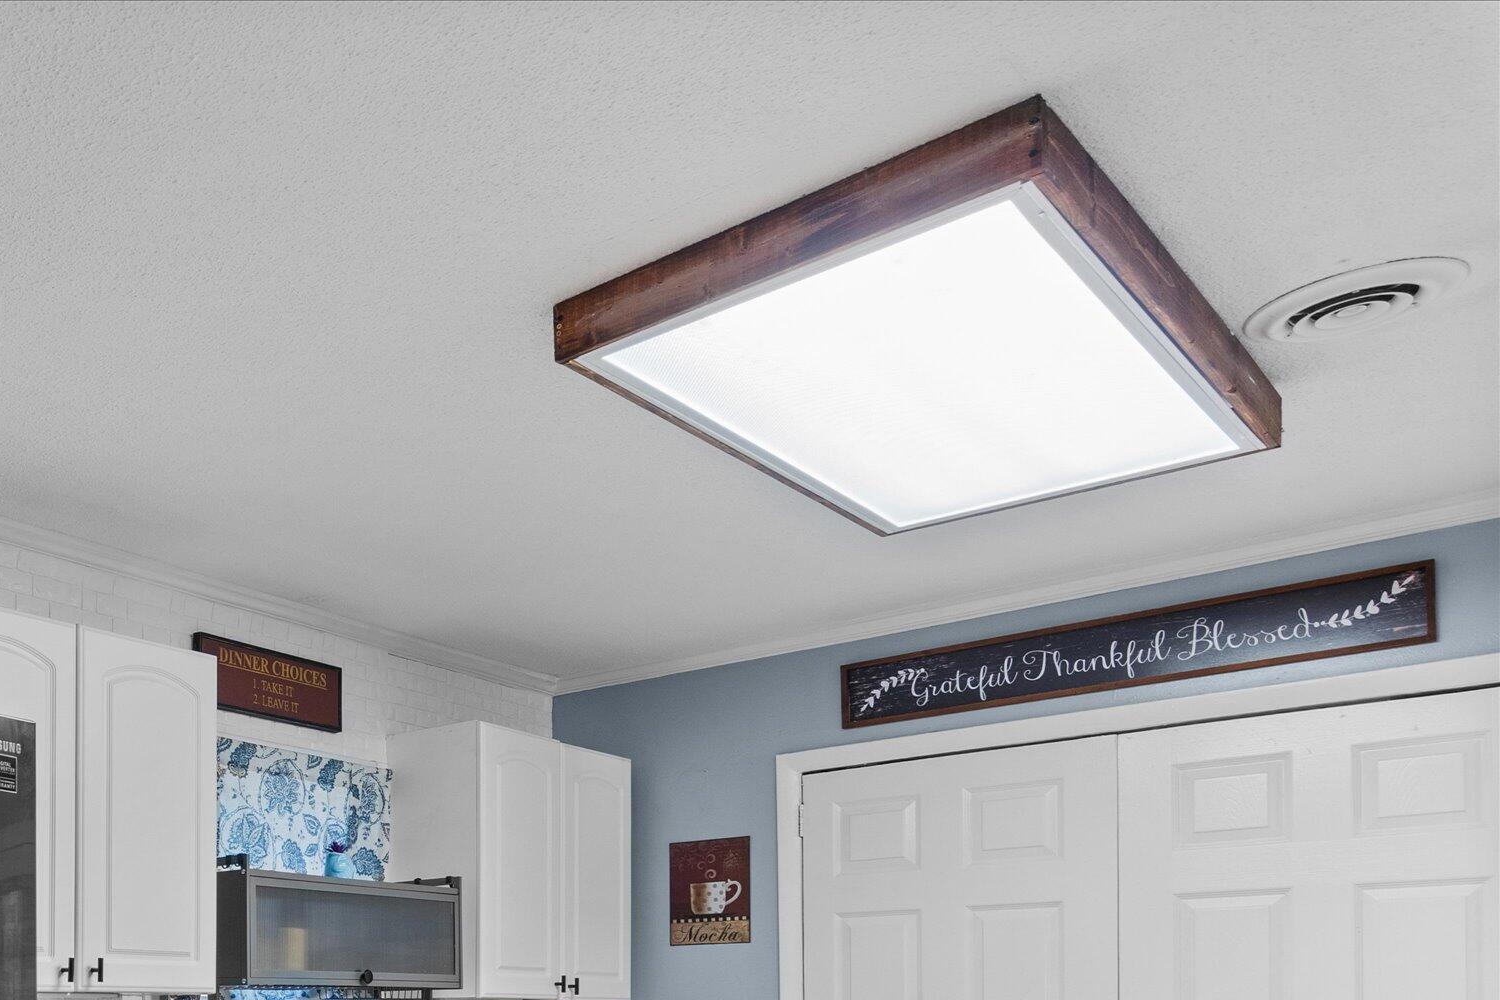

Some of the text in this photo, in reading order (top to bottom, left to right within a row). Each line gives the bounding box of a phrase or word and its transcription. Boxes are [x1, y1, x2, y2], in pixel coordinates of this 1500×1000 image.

[219, 647, 328, 688] DINNER CHOICES
[911, 607, 1312, 707] Grateful Thankful Blessed
[253, 678, 294, 698] 1. TAKE IT
[253, 693, 300, 714] 2. LEAVE IT
[678, 923, 742, 943] Mocha
